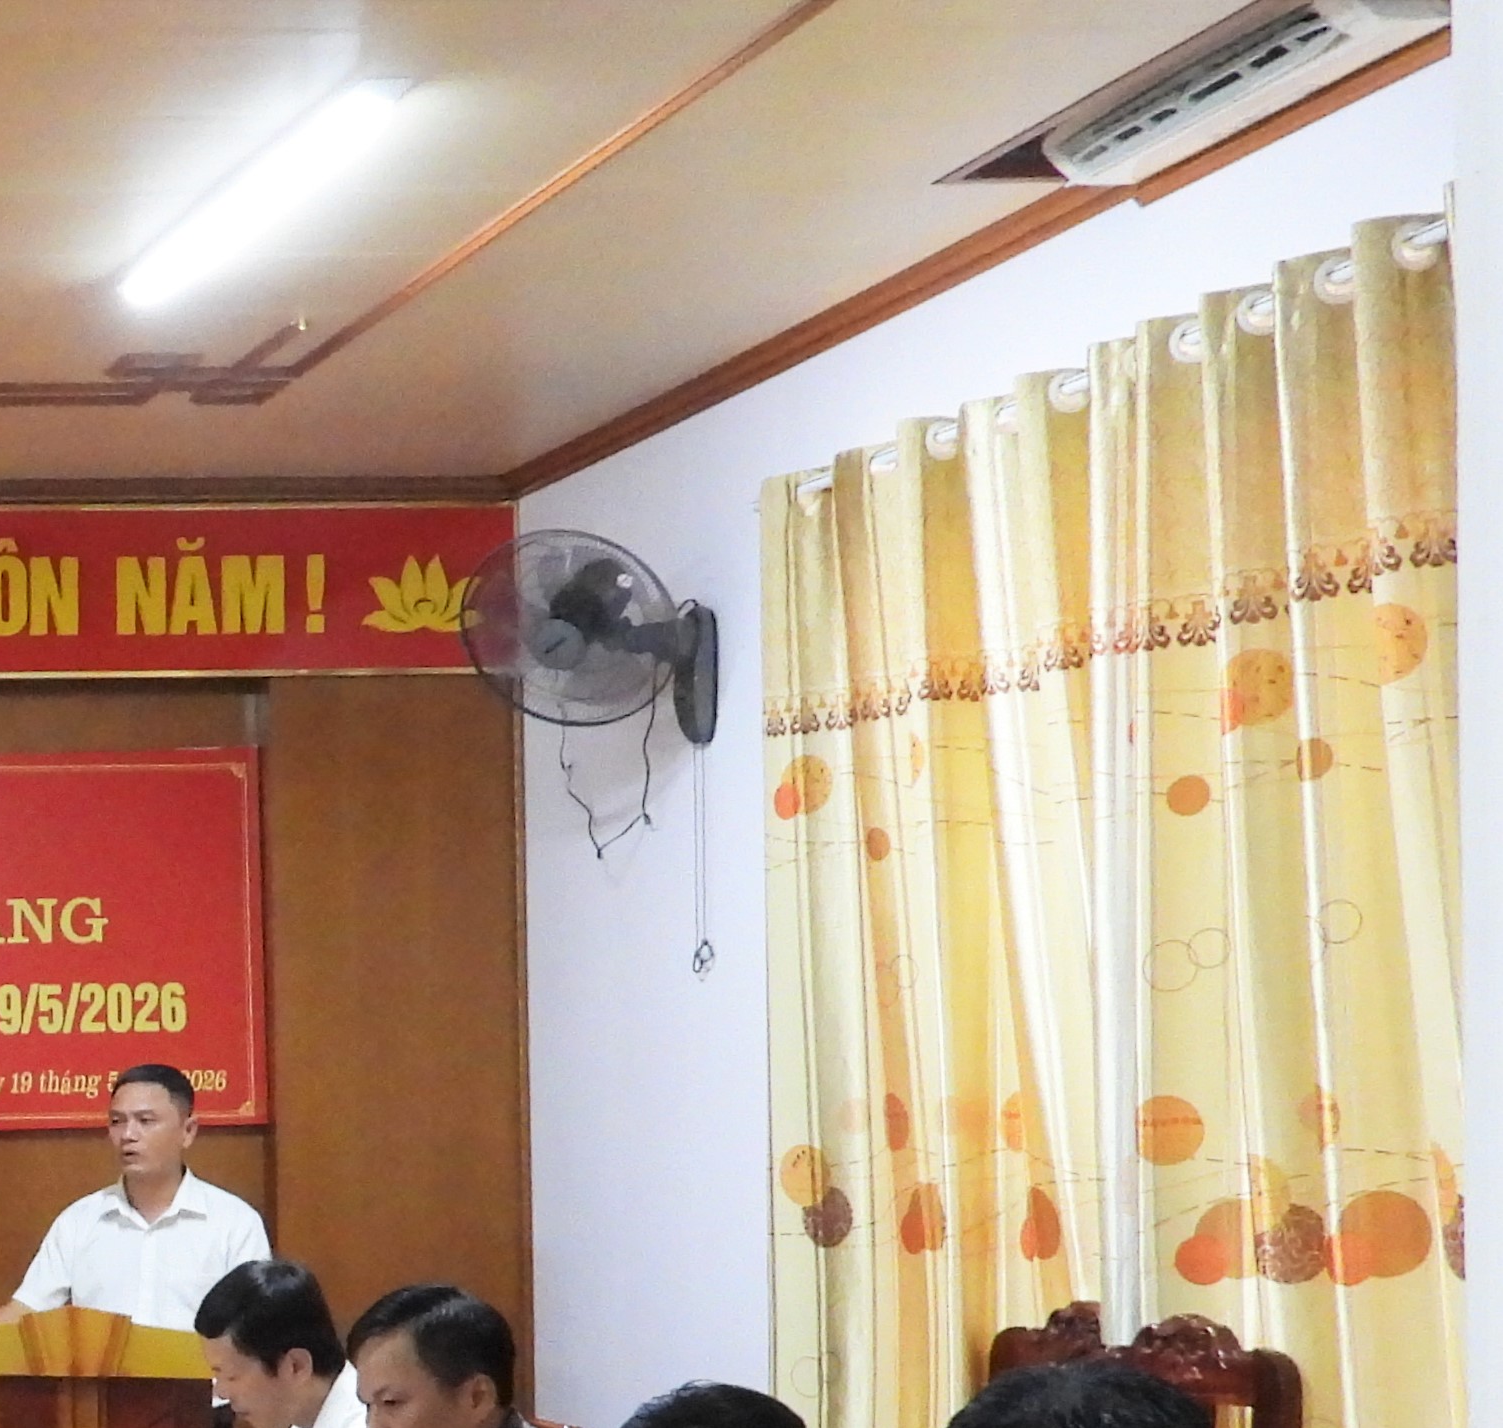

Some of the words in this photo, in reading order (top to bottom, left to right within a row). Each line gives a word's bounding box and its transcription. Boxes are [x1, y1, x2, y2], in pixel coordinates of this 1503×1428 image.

[117, 538, 285, 635] NĂM
[306, 554, 325, 633] !
[11, 1072, 32, 1093] 19
[40, 1070, 102, 1098] tháng
